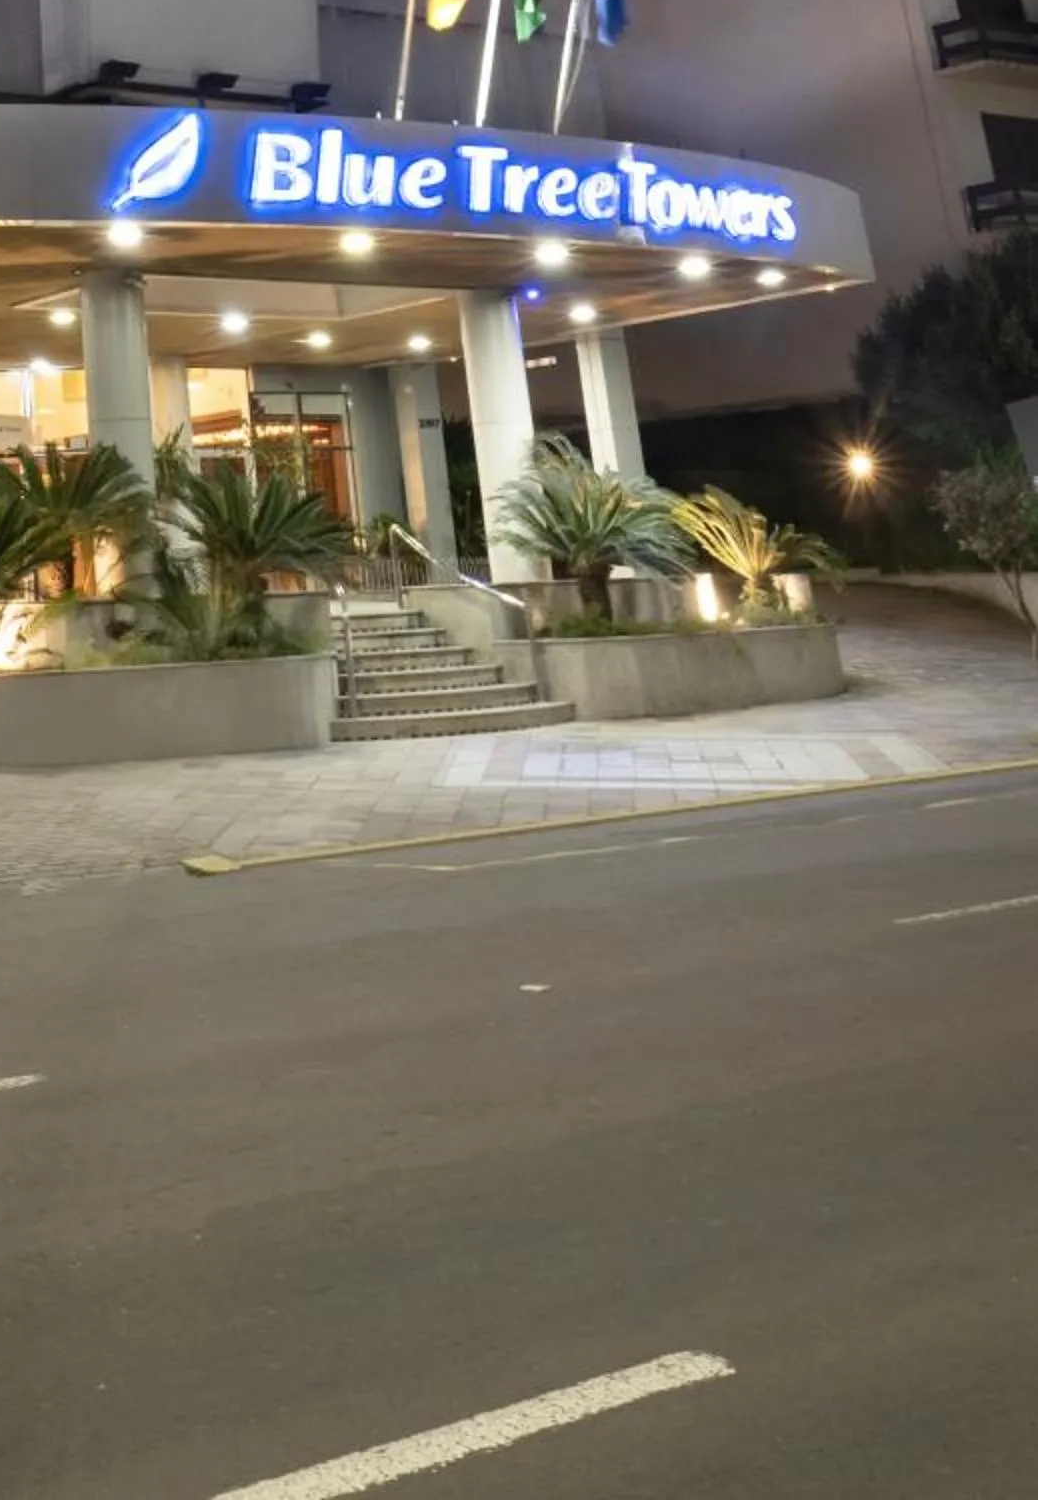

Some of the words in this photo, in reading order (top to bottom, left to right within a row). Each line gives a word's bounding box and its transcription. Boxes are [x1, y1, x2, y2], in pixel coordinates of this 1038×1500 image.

[250, 128, 448, 209] Blue
[457, 144, 620, 220] Tree
[617, 159, 797, 241] Towers
